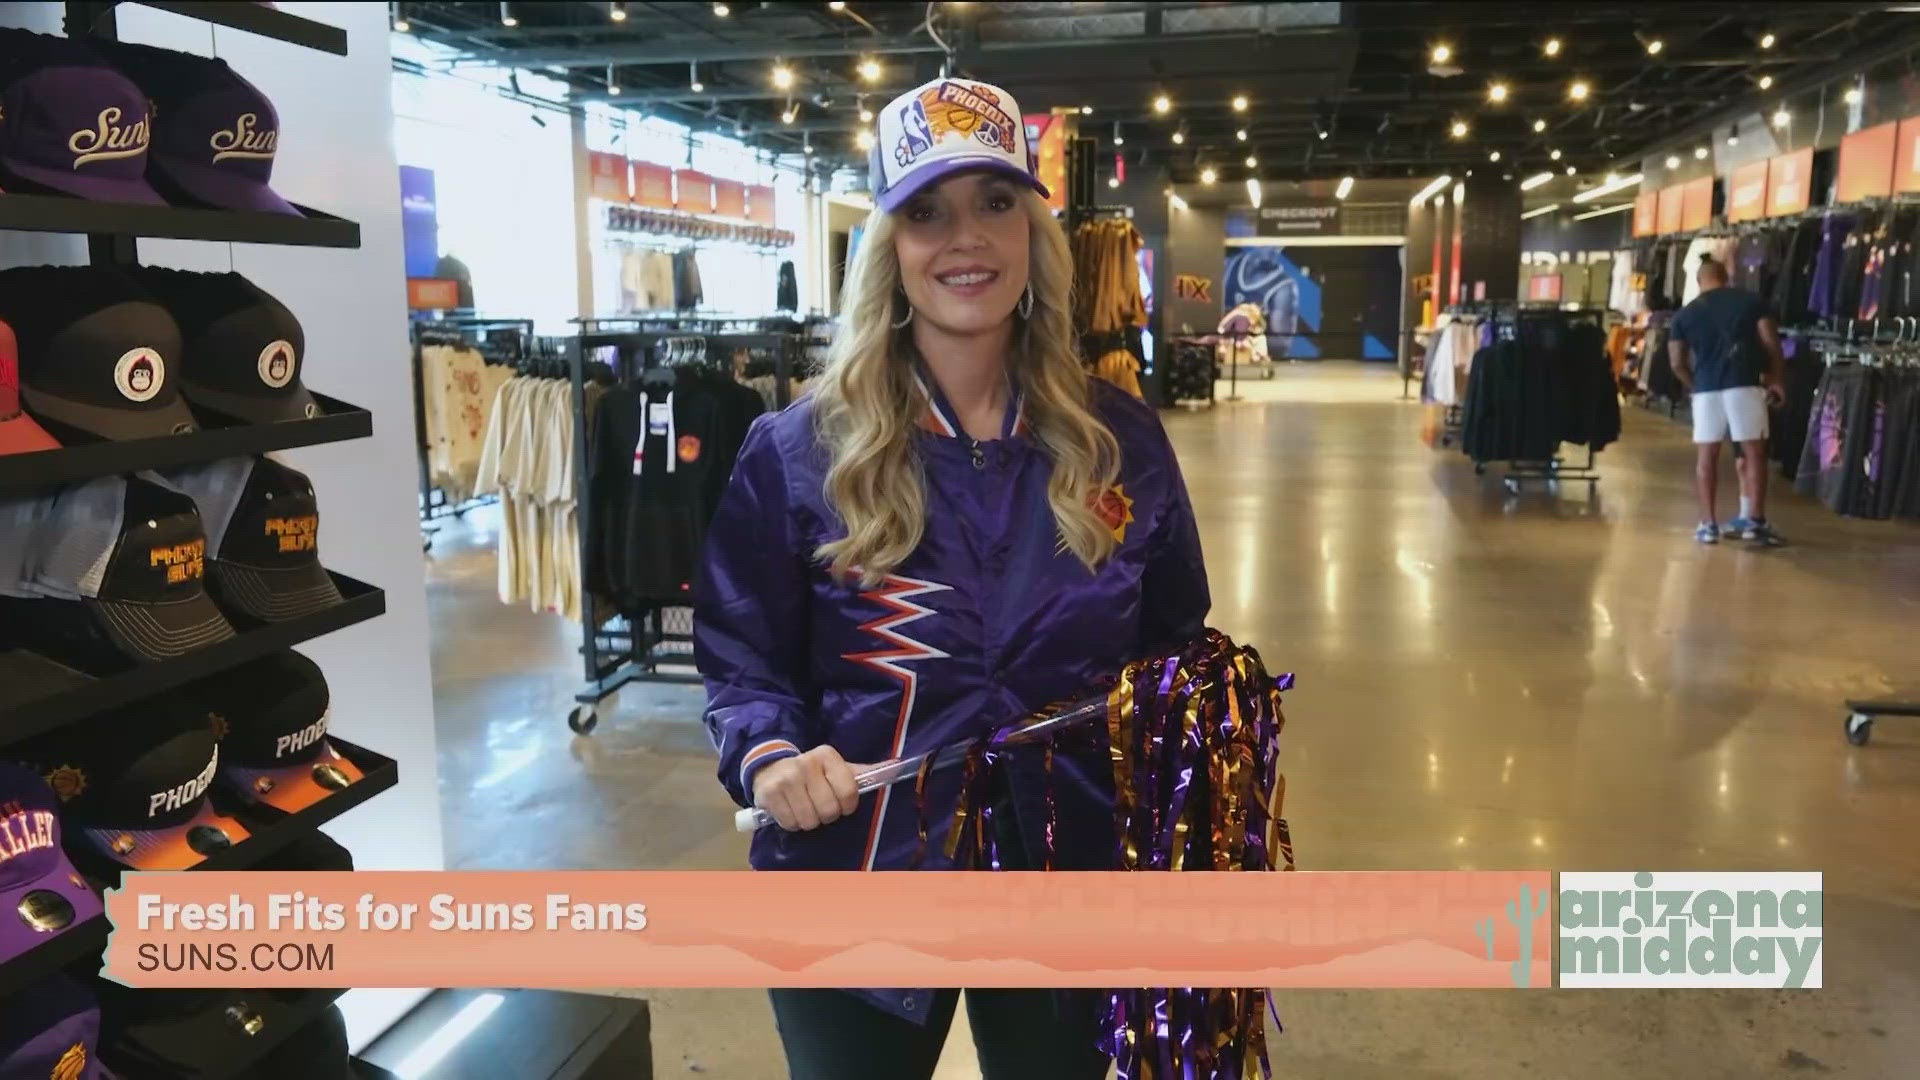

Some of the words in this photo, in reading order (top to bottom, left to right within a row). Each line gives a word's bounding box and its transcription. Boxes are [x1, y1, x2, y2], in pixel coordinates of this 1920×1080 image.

[941, 84, 1012, 130] PHOENIX
[210, 113, 278, 164] Sun
[1261, 207, 1338, 218] CHECKOUT
[276, 708, 330, 759] PHOE
